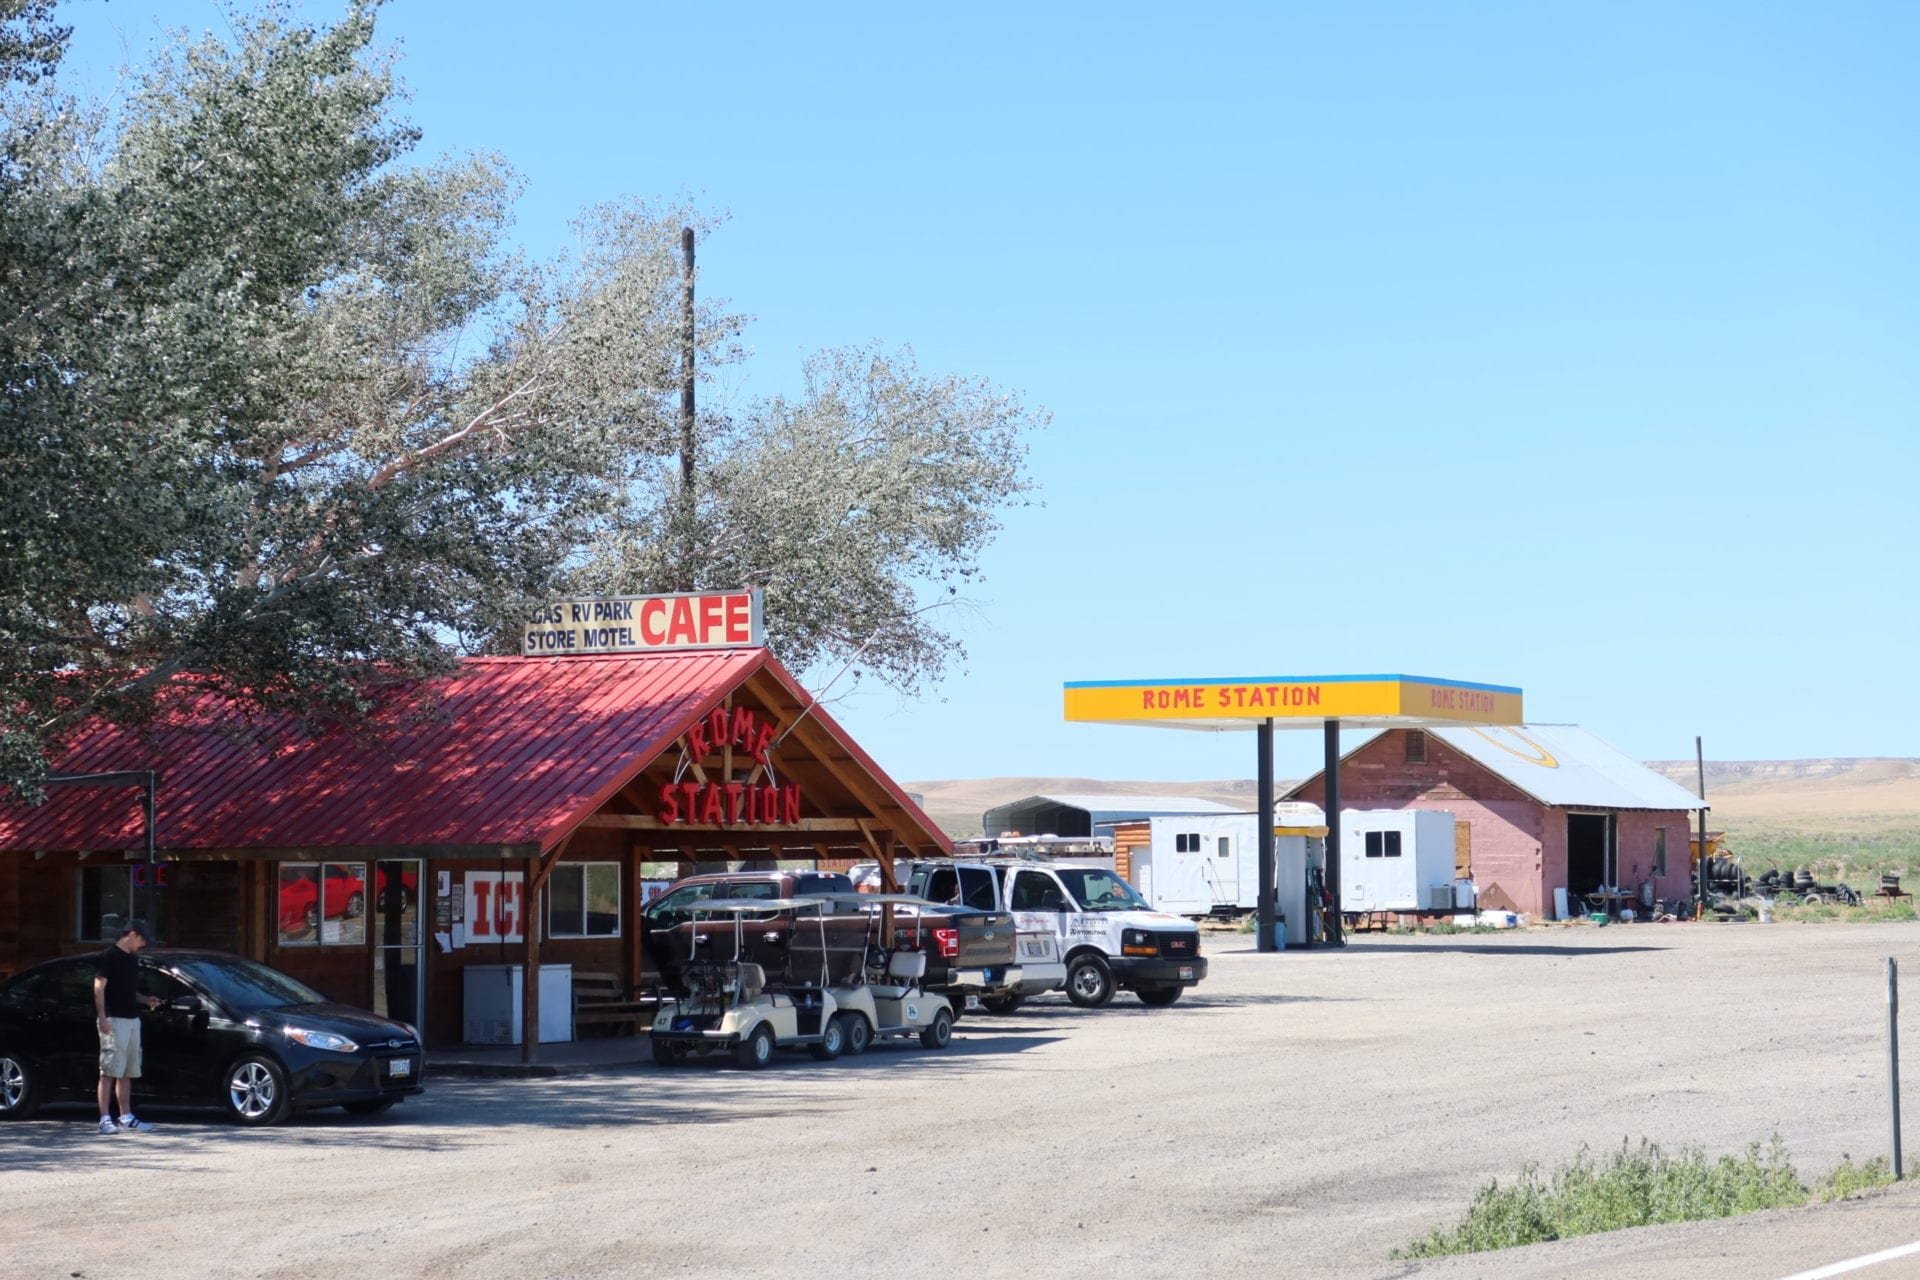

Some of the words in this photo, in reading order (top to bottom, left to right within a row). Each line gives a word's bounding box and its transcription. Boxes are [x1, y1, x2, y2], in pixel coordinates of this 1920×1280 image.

[571, 603, 592, 623] RV
[595, 601, 633, 621] PARK
[640, 595, 749, 646] CAFE
[527, 629, 576, 650] STORE
[584, 627, 636, 648] MOTEL
[1143, 687, 1205, 709] ROME
[1218, 685, 1321, 708] STATION
[1431, 687, 1455, 710] ROME
[1459, 691, 1495, 713] STATION
[688, 706, 777, 764] ROME
[660, 783, 801, 826] STATION
